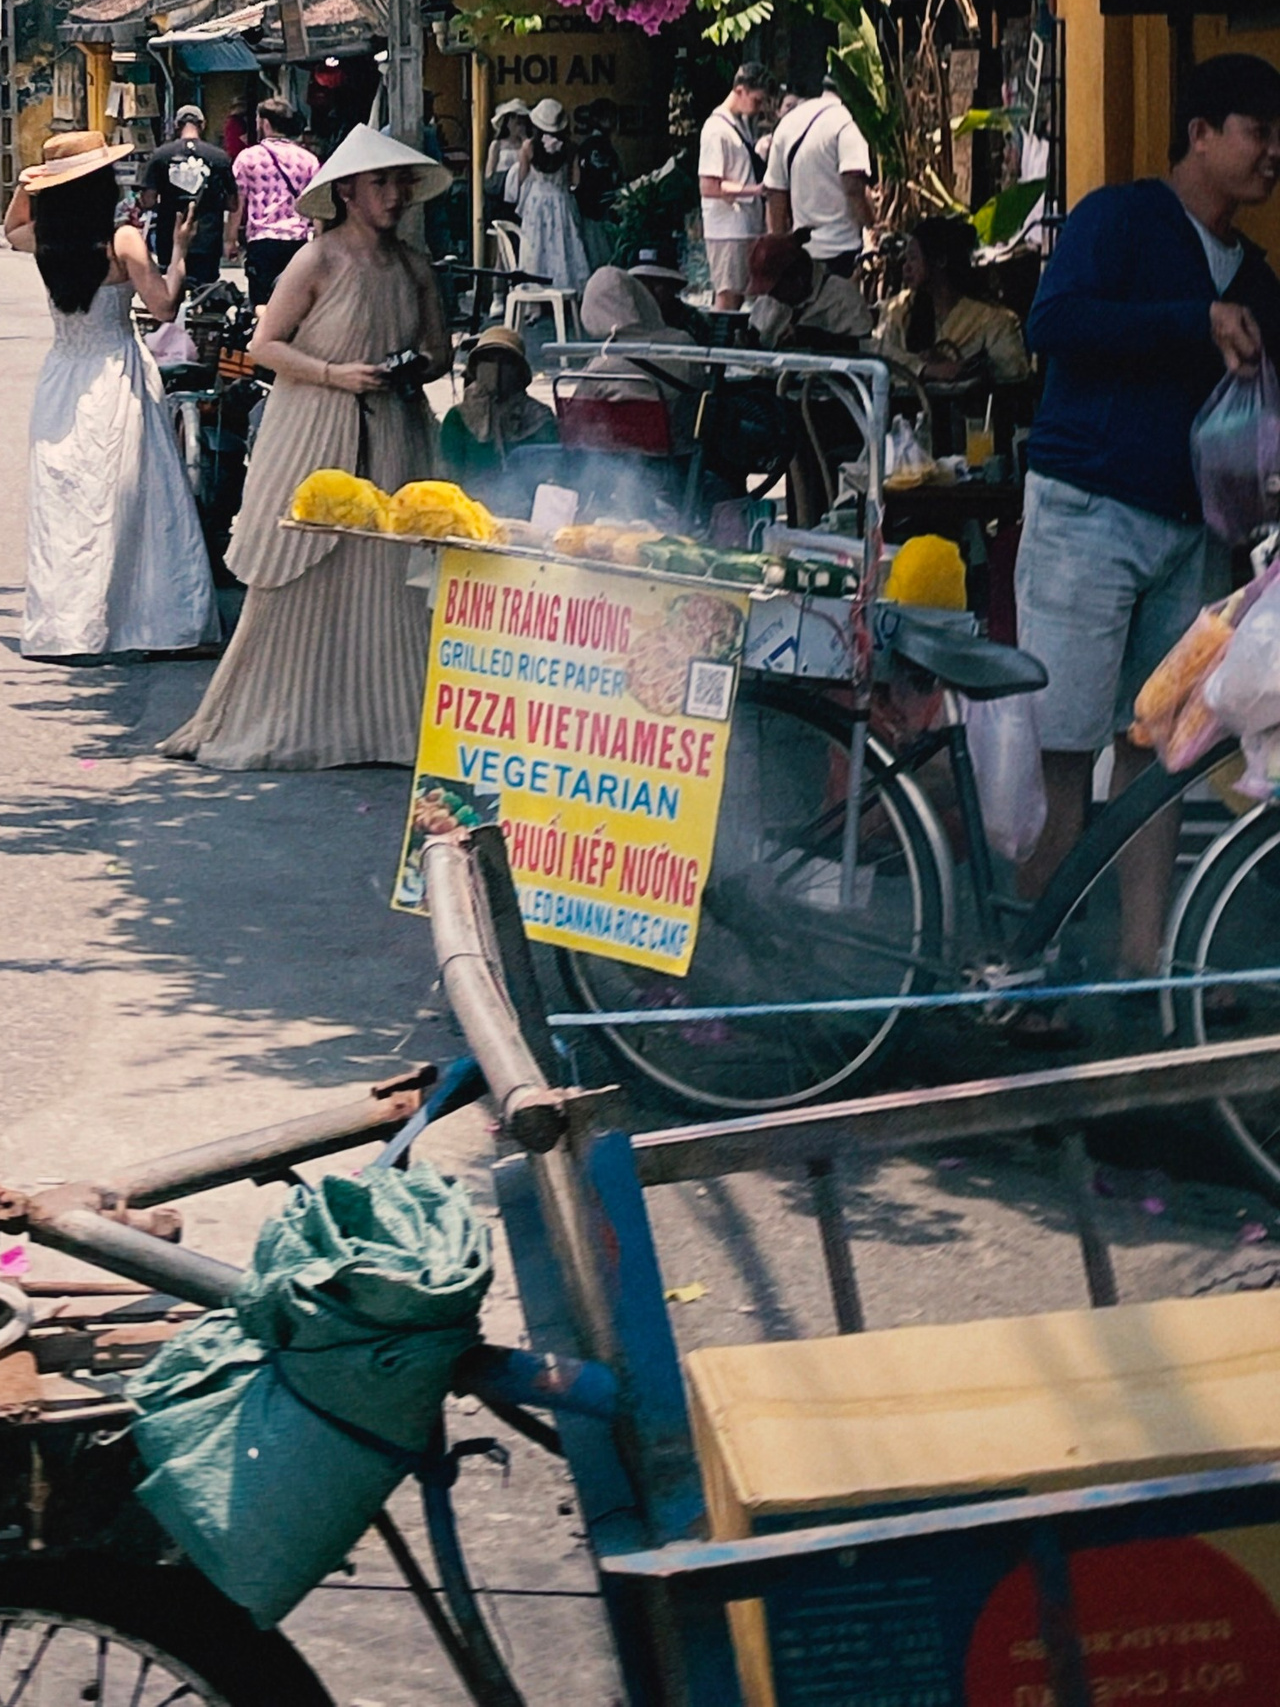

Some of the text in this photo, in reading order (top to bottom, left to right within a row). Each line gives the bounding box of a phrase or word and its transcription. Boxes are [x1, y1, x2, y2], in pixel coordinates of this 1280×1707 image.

[497, 54, 616, 85] HOI AN
[444, 570, 633, 654] BÁNH TRÁNG NƯỚNG
[439, 640, 626, 698] GRILLED RICE PAPER
[435, 683, 716, 778] PIZZA VIETNAMESE
[458, 745, 680, 821] VEGETARIAN
[569, 823, 616, 889] NẾP
[618, 842, 700, 908] NƯỚNG
[555, 894, 615, 943] BANANA
[615, 909, 651, 949] RICE
[648, 916, 691, 958] CAKE
